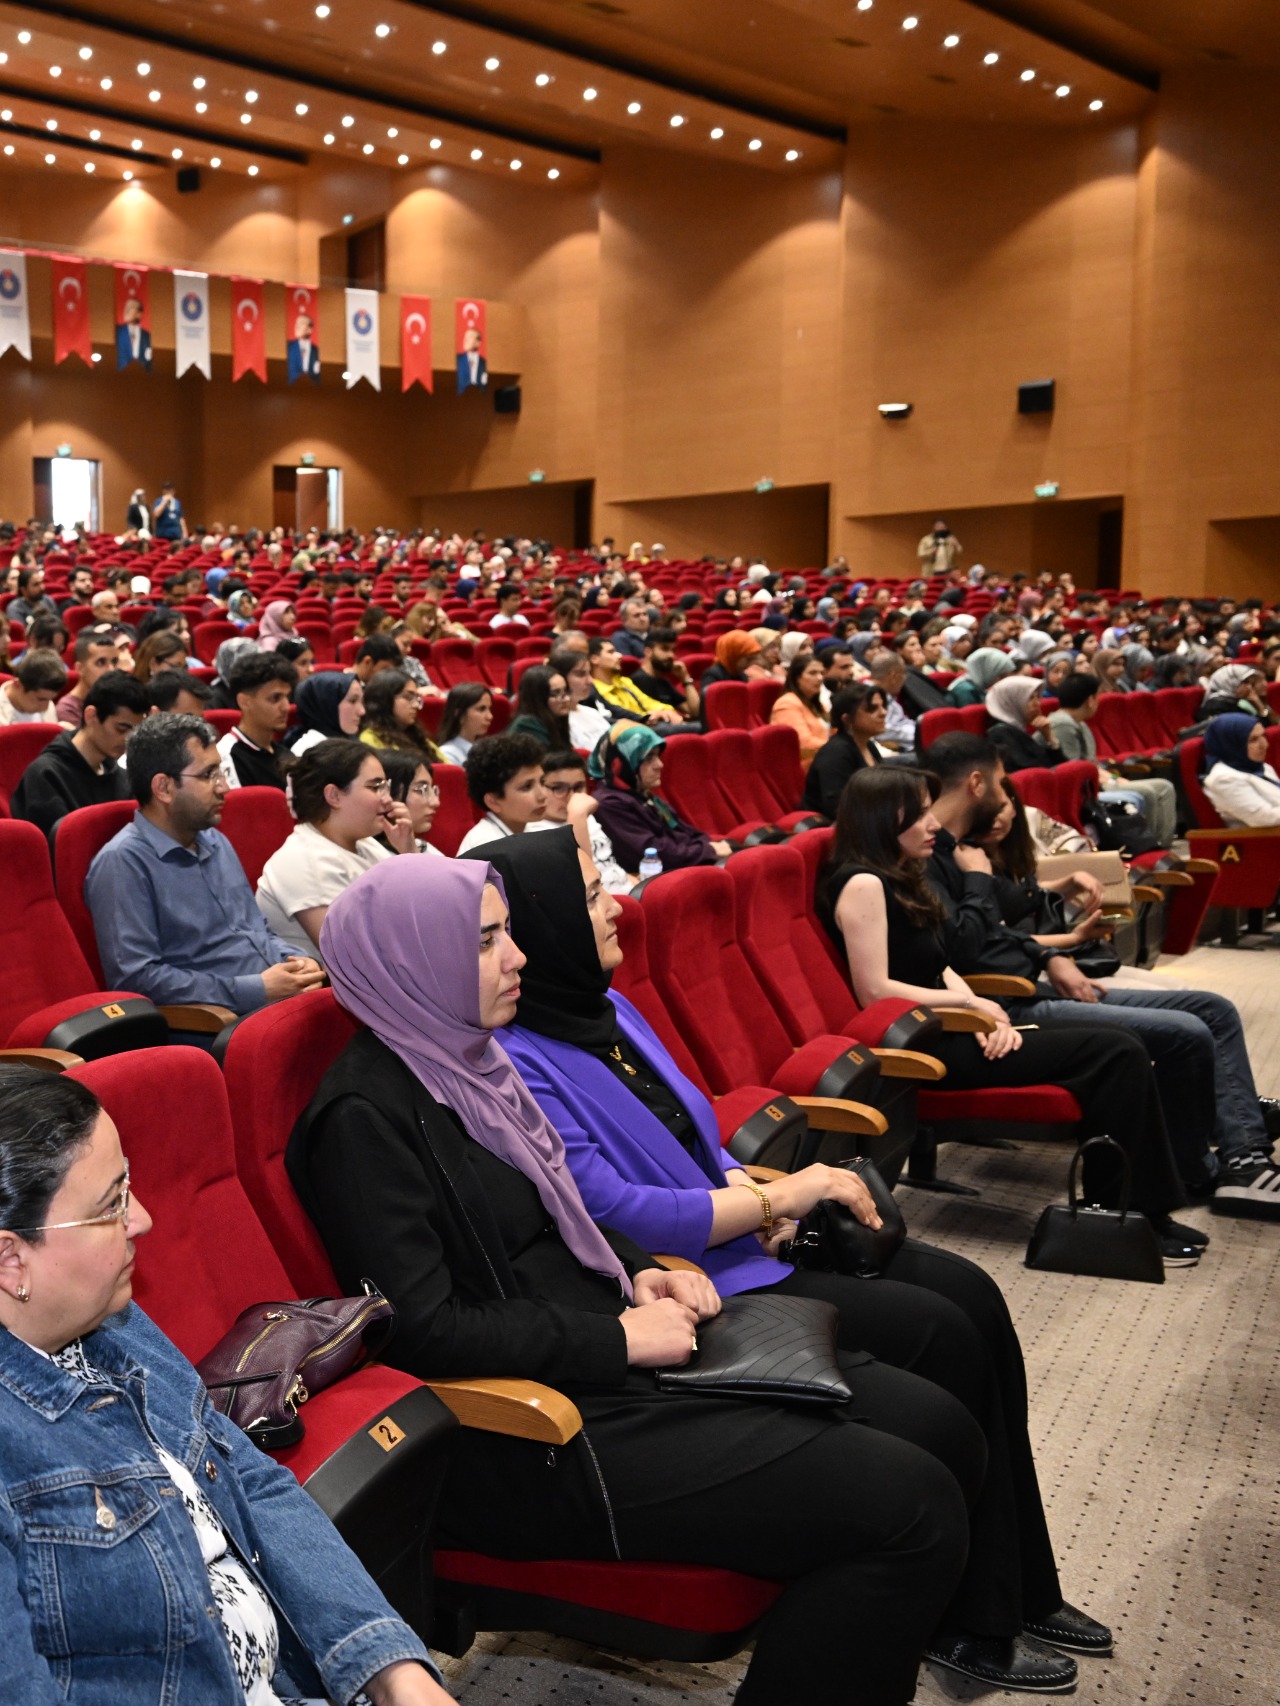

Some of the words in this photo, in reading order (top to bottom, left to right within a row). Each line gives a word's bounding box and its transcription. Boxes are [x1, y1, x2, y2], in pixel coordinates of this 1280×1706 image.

[1221, 844, 1240, 862] A
[110, 1006, 119, 1015] 4
[378, 1424, 398, 1444] 2
